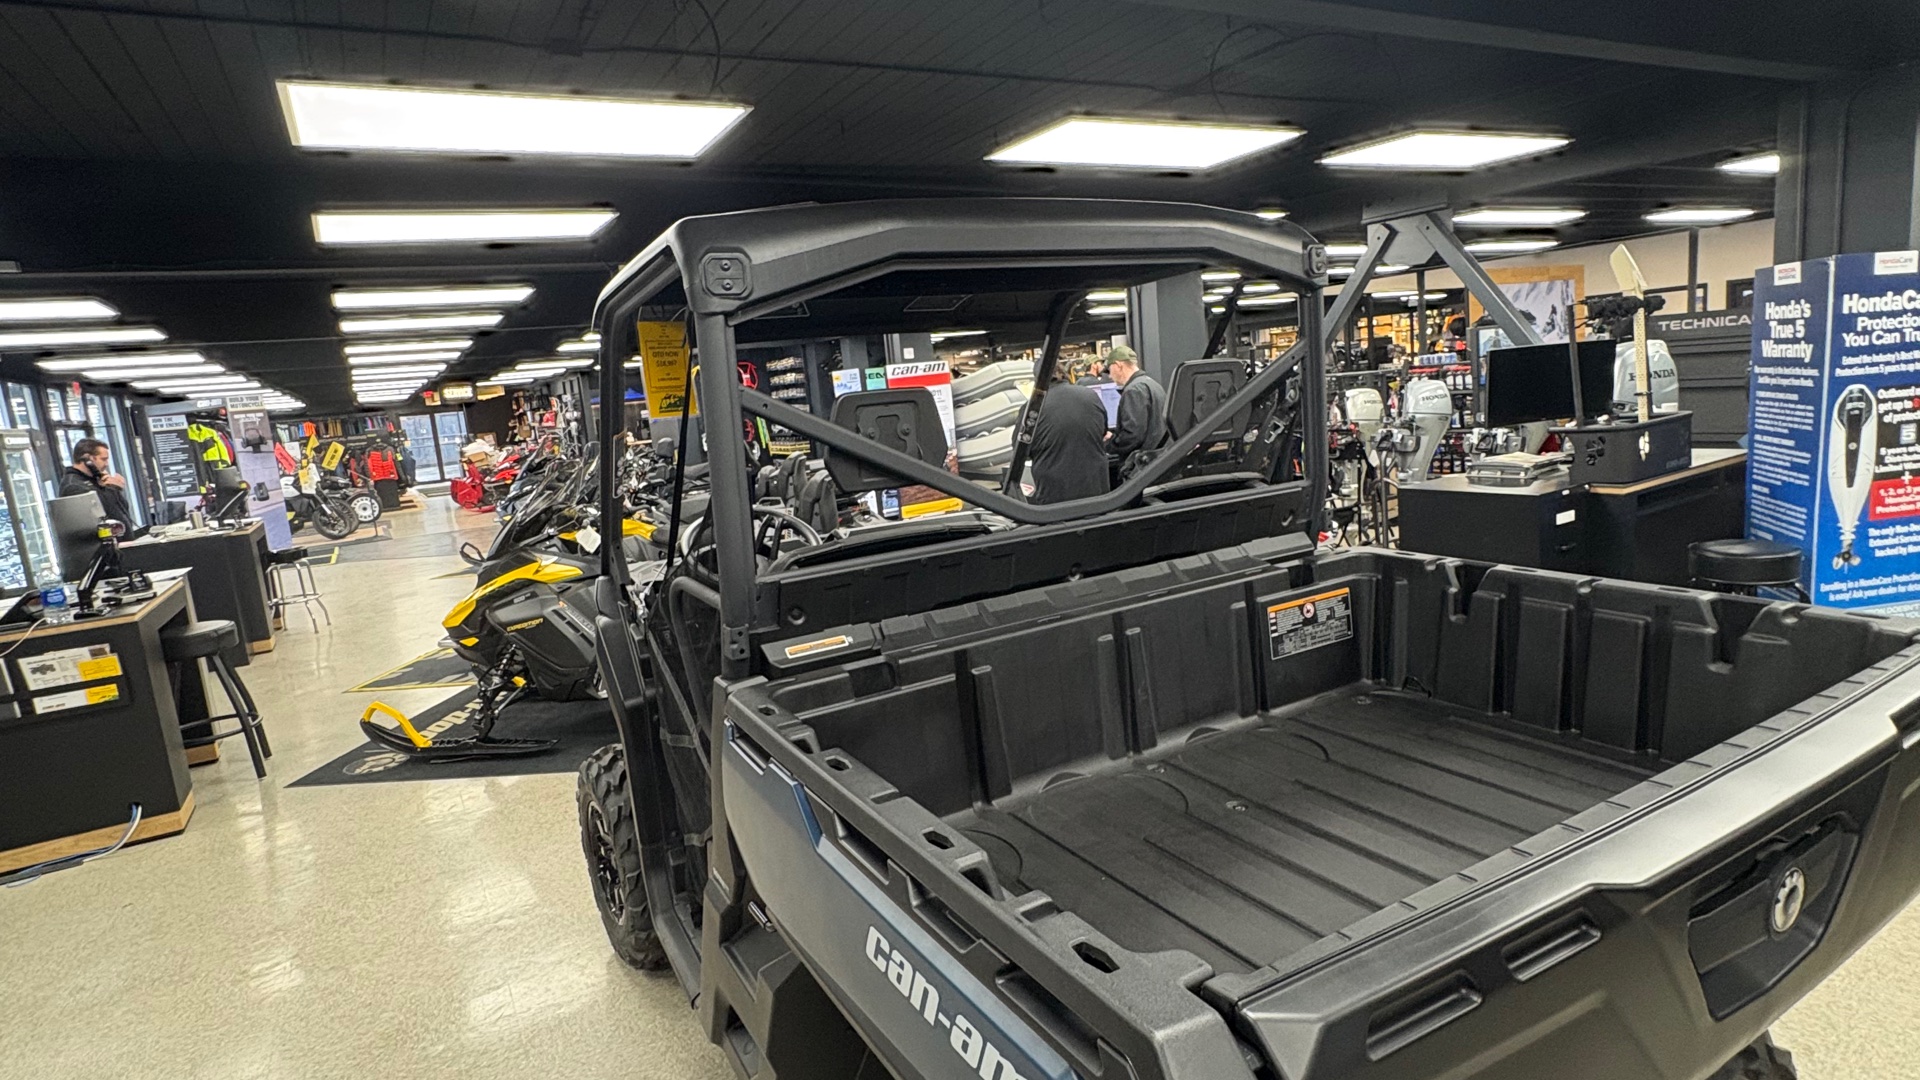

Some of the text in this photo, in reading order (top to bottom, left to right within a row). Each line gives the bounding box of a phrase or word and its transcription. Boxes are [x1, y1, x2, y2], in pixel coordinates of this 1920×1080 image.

[1765, 299, 1812, 321] Honda's
[1658, 314, 1753, 331] TECHNICA
[1769, 319, 1805, 339] True 5
[1842, 331, 1869, 348] You
[1871, 330, 1900, 345] Can
[1761, 339, 1814, 363] Warranty
[891, 362, 946, 377] can-am
[1628, 368, 1675, 382] HNDA
